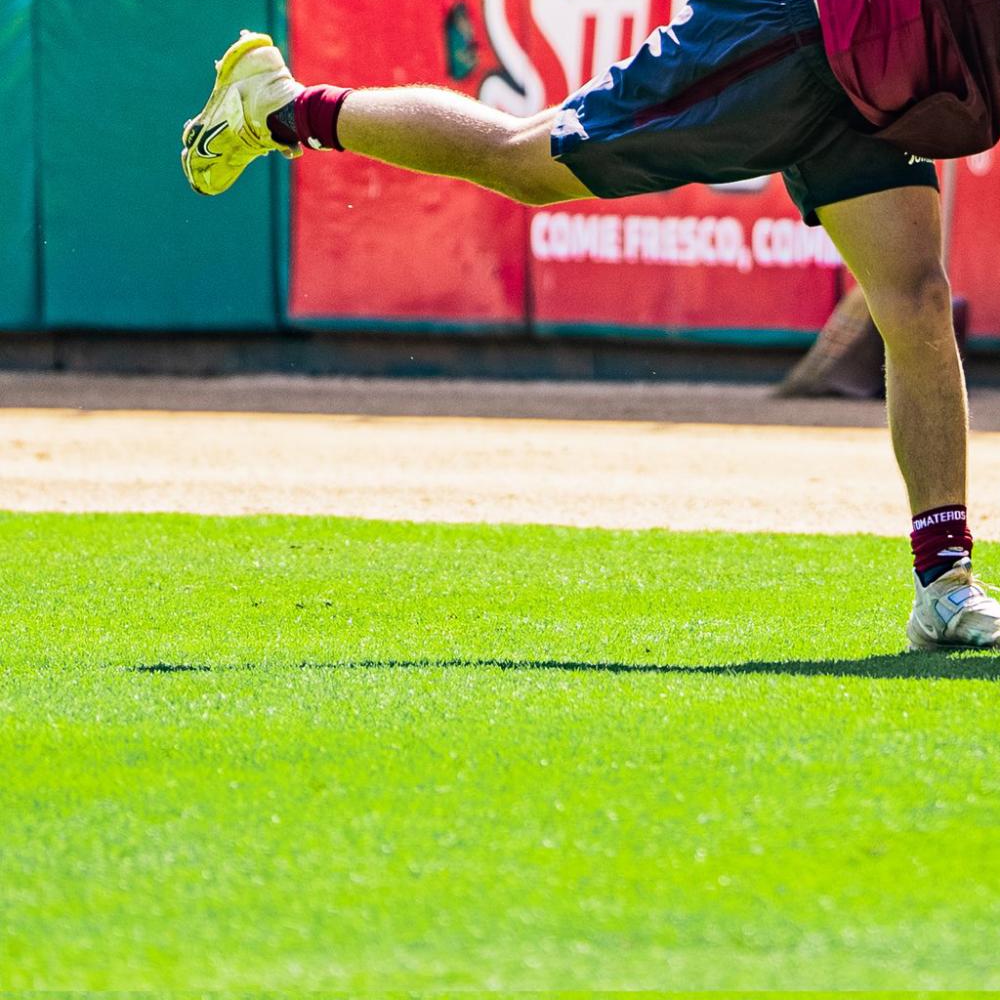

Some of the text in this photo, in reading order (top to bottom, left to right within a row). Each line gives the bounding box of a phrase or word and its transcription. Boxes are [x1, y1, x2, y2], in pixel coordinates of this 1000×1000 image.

[531, 211, 622, 262] COME
[622, 214, 752, 272] FRESCO,
[913, 510, 966, 531] TOMATEROS
